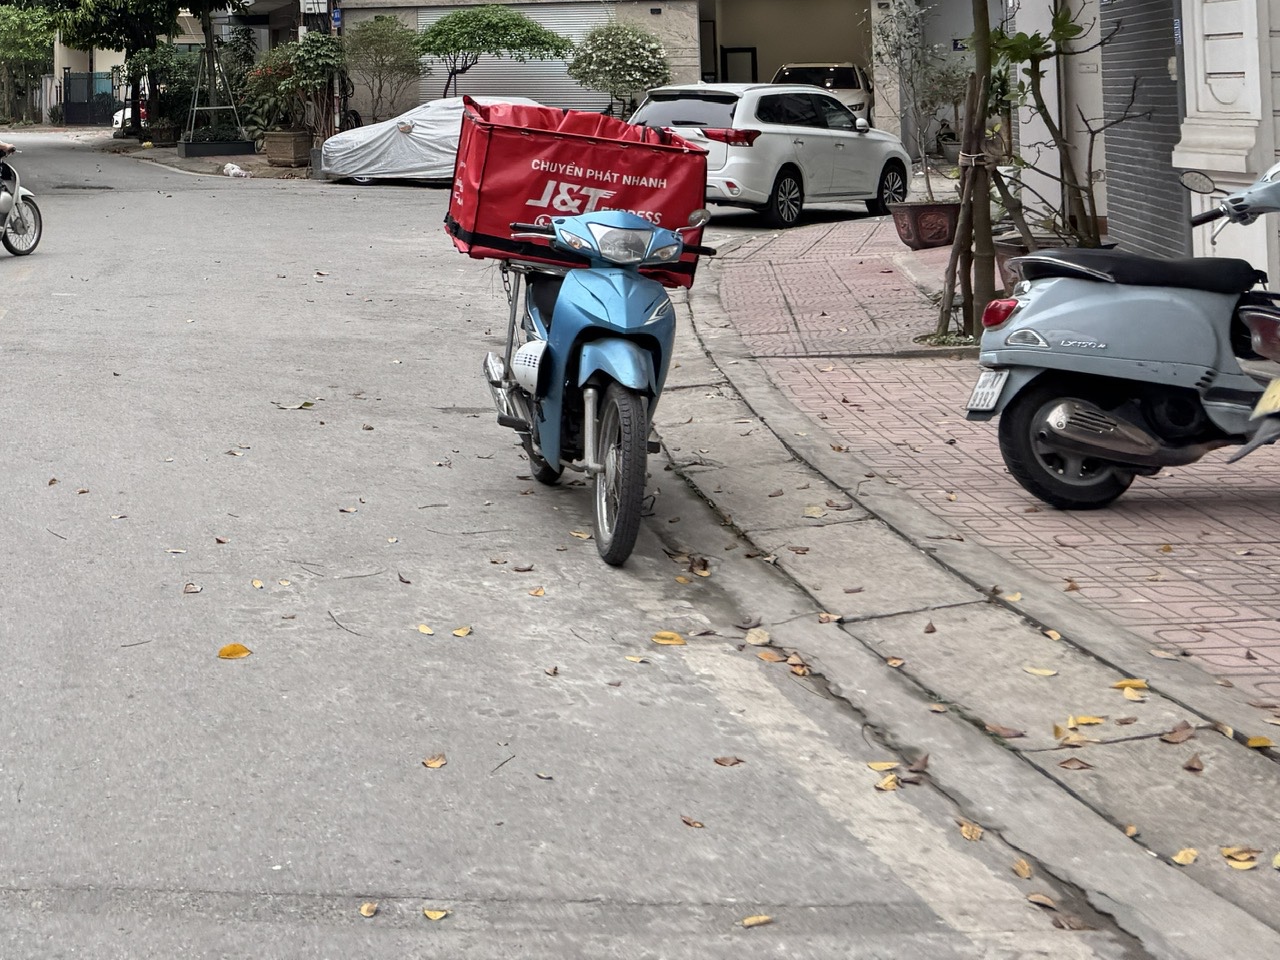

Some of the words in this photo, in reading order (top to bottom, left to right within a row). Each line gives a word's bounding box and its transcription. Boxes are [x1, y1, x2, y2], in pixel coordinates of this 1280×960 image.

[531, 159, 583, 177] CHUYỂN
[586, 169, 620, 183] PHÁT
[622, 174, 667, 189] NHANH
[525, 179, 618, 214] J&T
